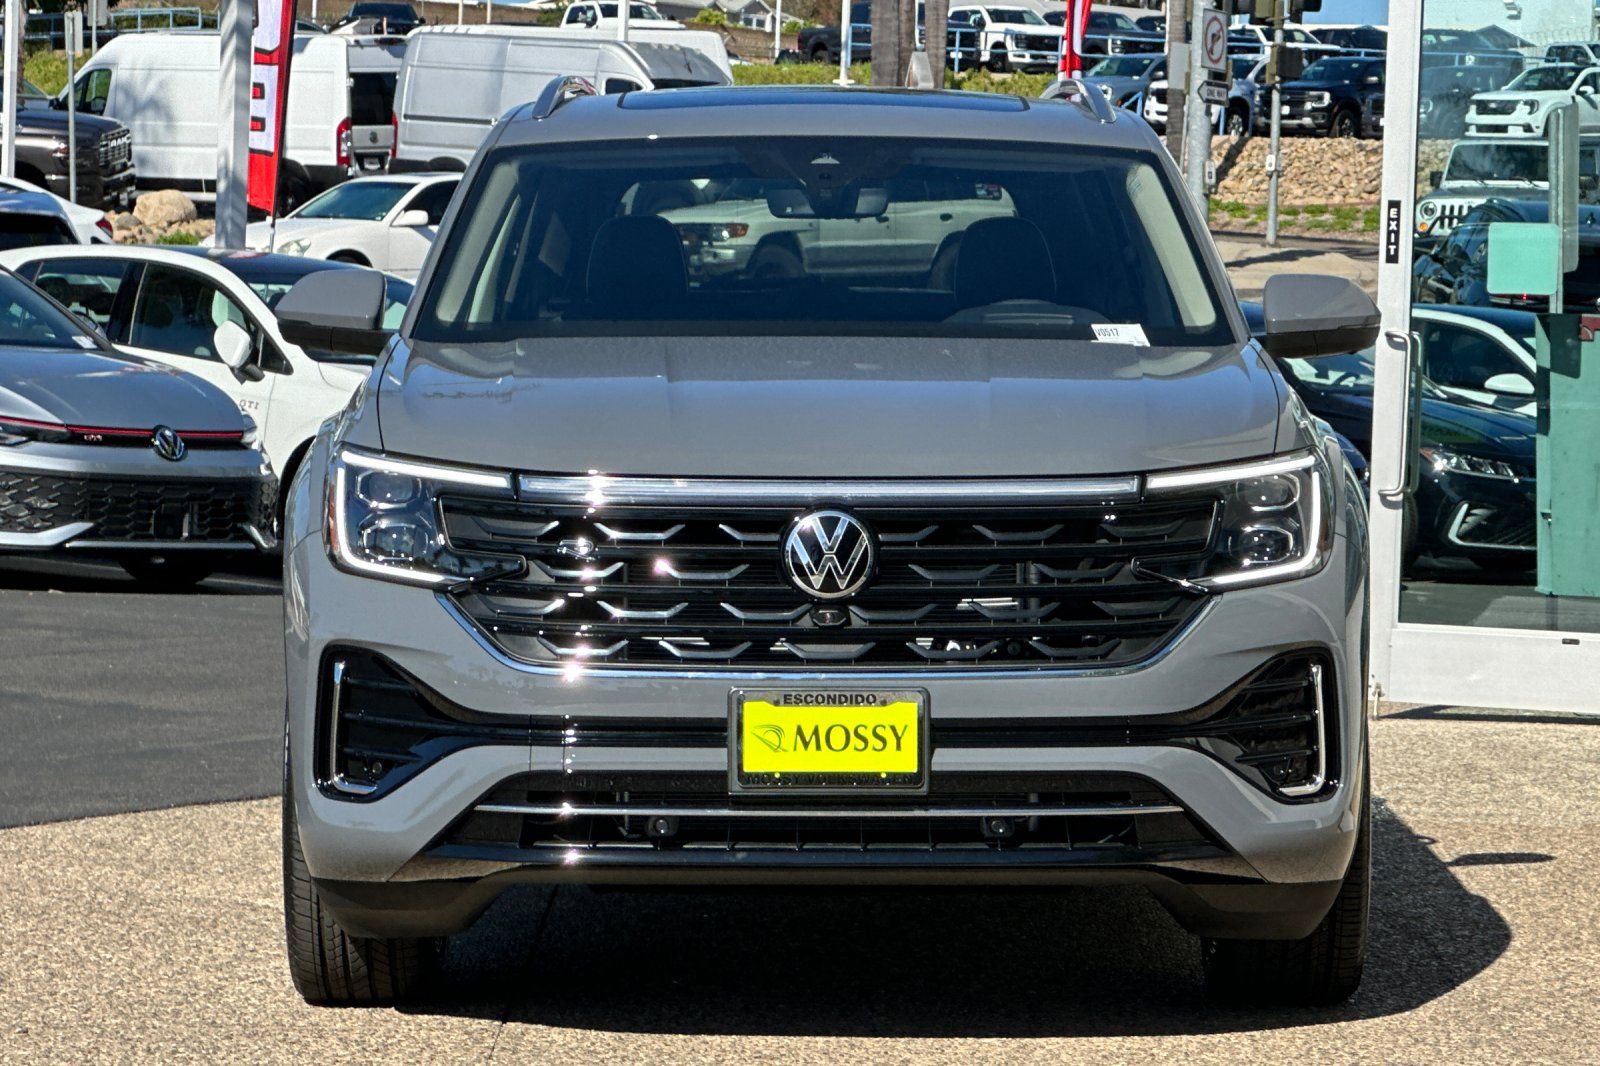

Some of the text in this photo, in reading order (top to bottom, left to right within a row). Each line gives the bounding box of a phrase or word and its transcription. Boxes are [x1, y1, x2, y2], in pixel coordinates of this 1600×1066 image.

[1388, 207, 1398, 256] EXIT
[783, 693, 877, 706] ESCONDIDO
[793, 724, 908, 752] MOSSY
